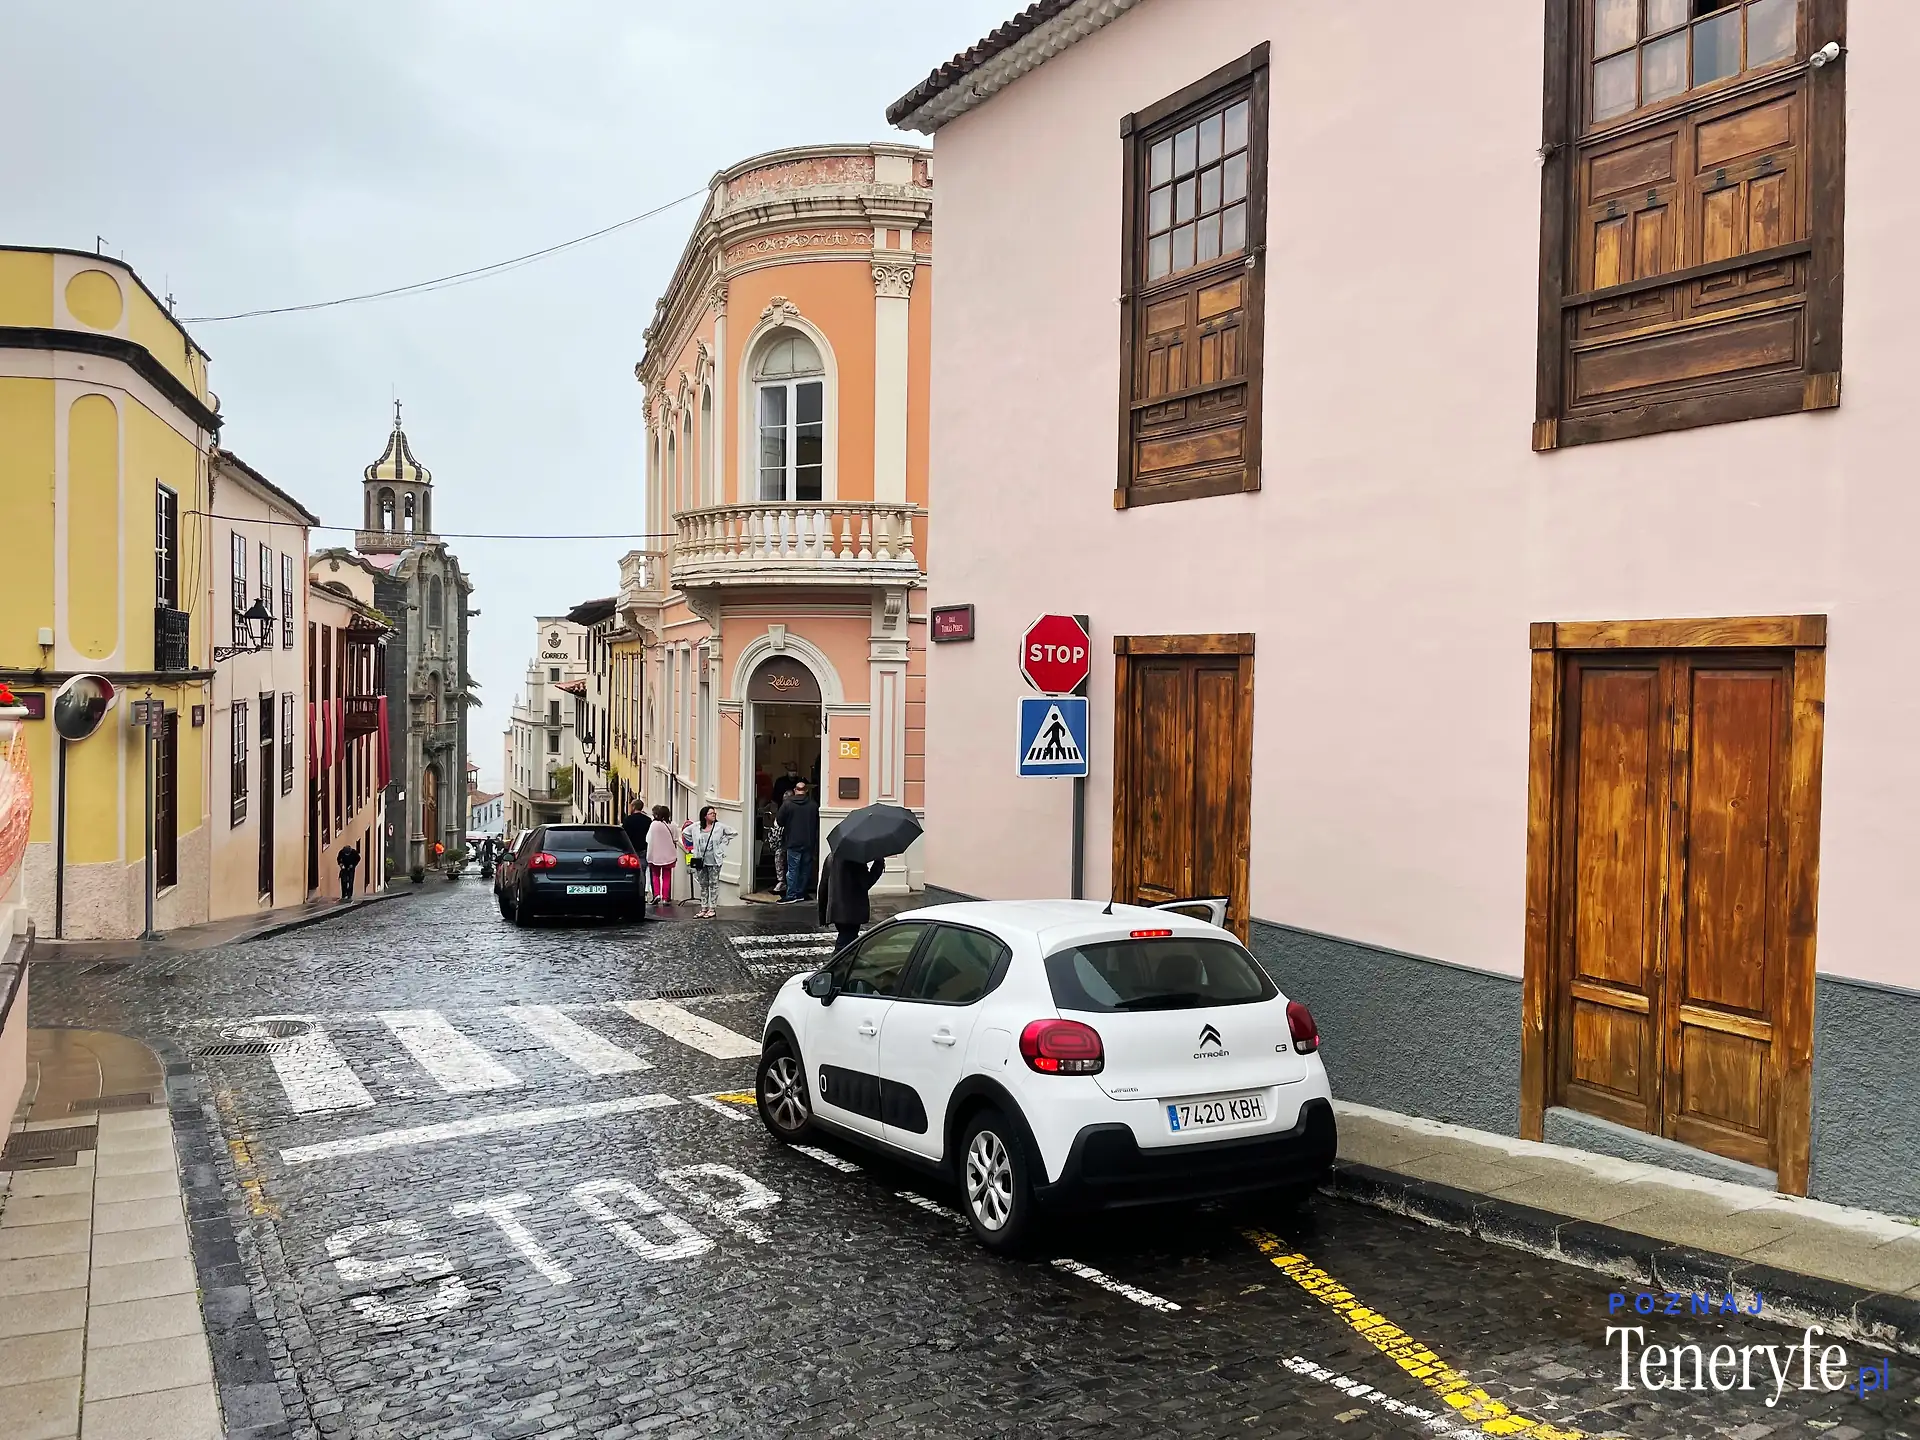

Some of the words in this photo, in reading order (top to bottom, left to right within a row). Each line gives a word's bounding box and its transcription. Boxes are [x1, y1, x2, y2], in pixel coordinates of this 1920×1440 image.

[1030, 643, 1084, 664] STOP
[1275, 1044, 1287, 1053] C3
[1180, 1102, 1225, 1127] 7420
[1228, 1097, 1262, 1120] KBH
[324, 1162, 783, 1323] STOP
